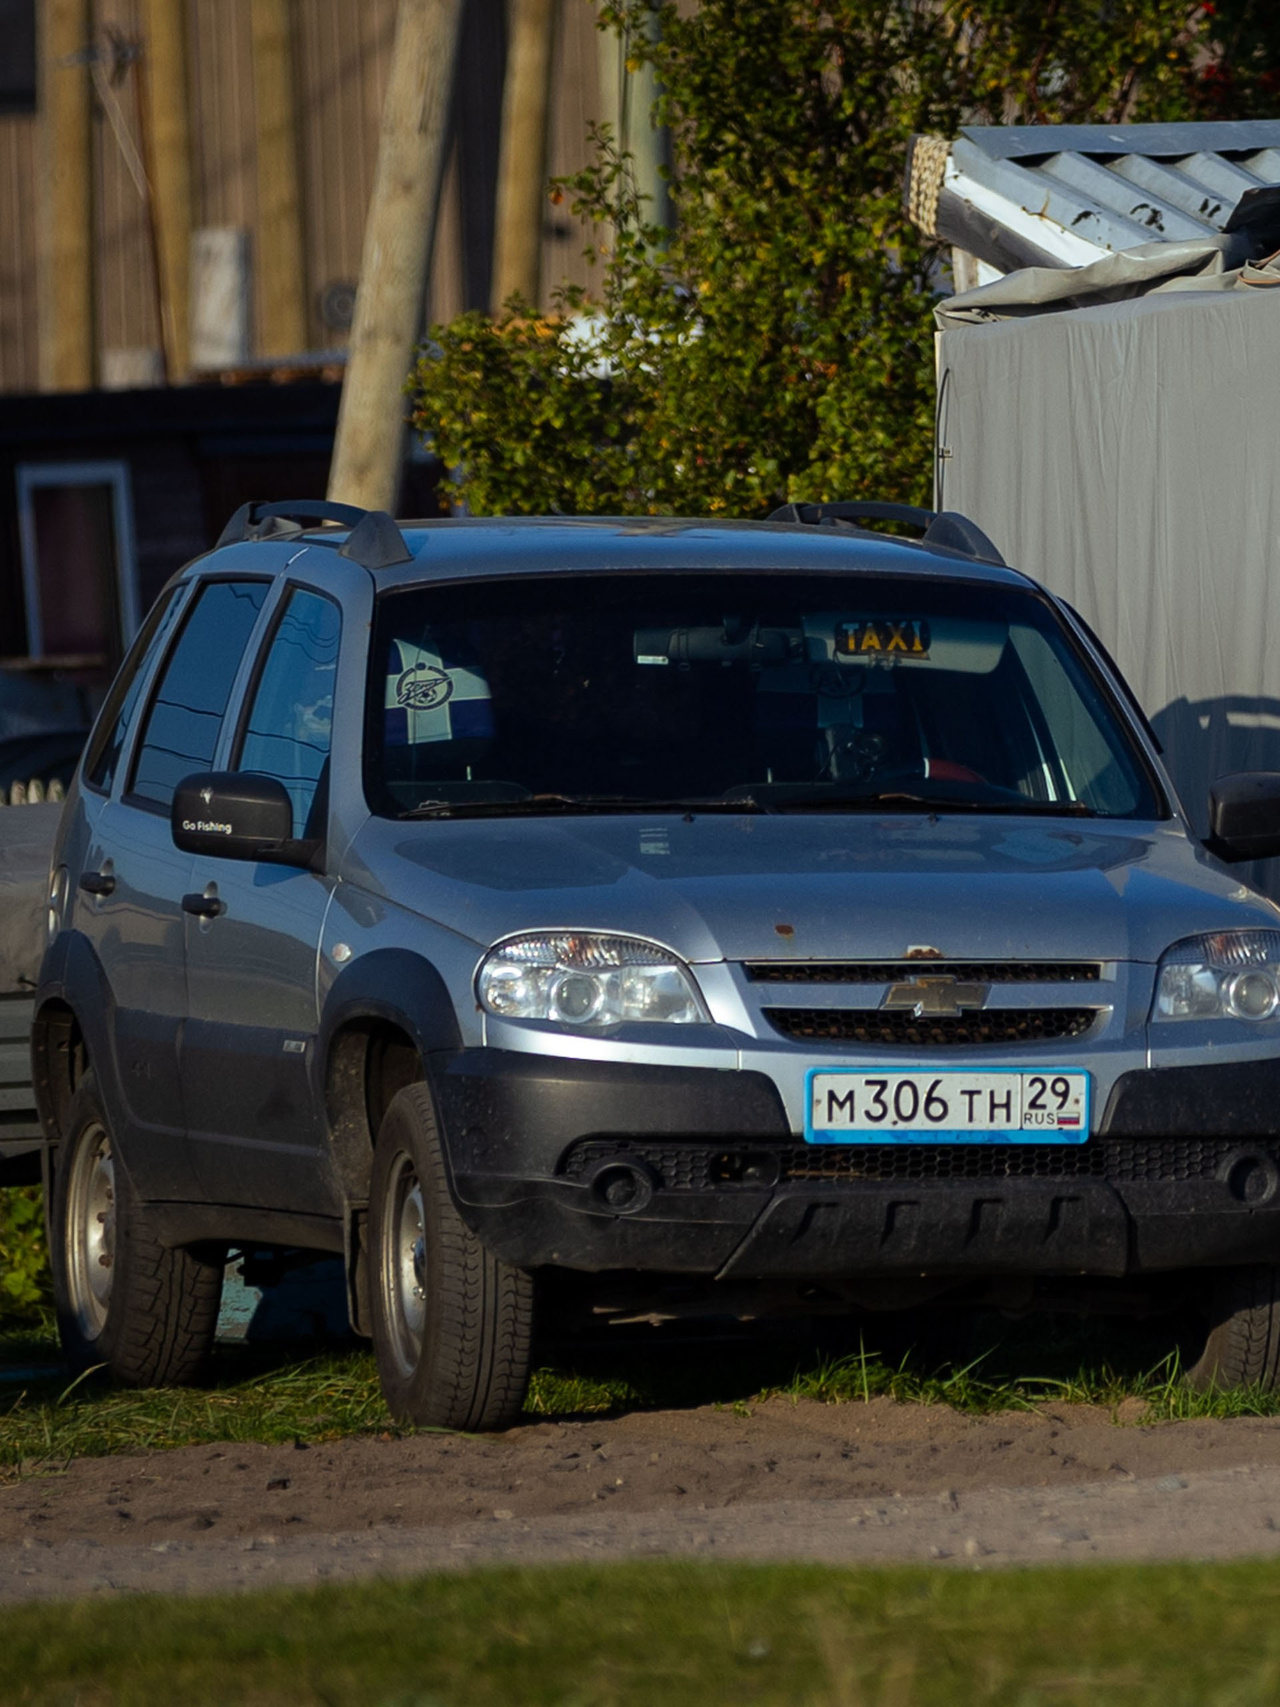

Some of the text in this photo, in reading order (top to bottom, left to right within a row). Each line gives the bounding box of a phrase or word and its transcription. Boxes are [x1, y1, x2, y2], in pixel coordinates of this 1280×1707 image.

[842, 620, 924, 651] TAXI
[183, 820, 232, 834] Go Fishing
[1028, 1077, 1070, 1110] 29
[1024, 1112, 1055, 1125] RUS
